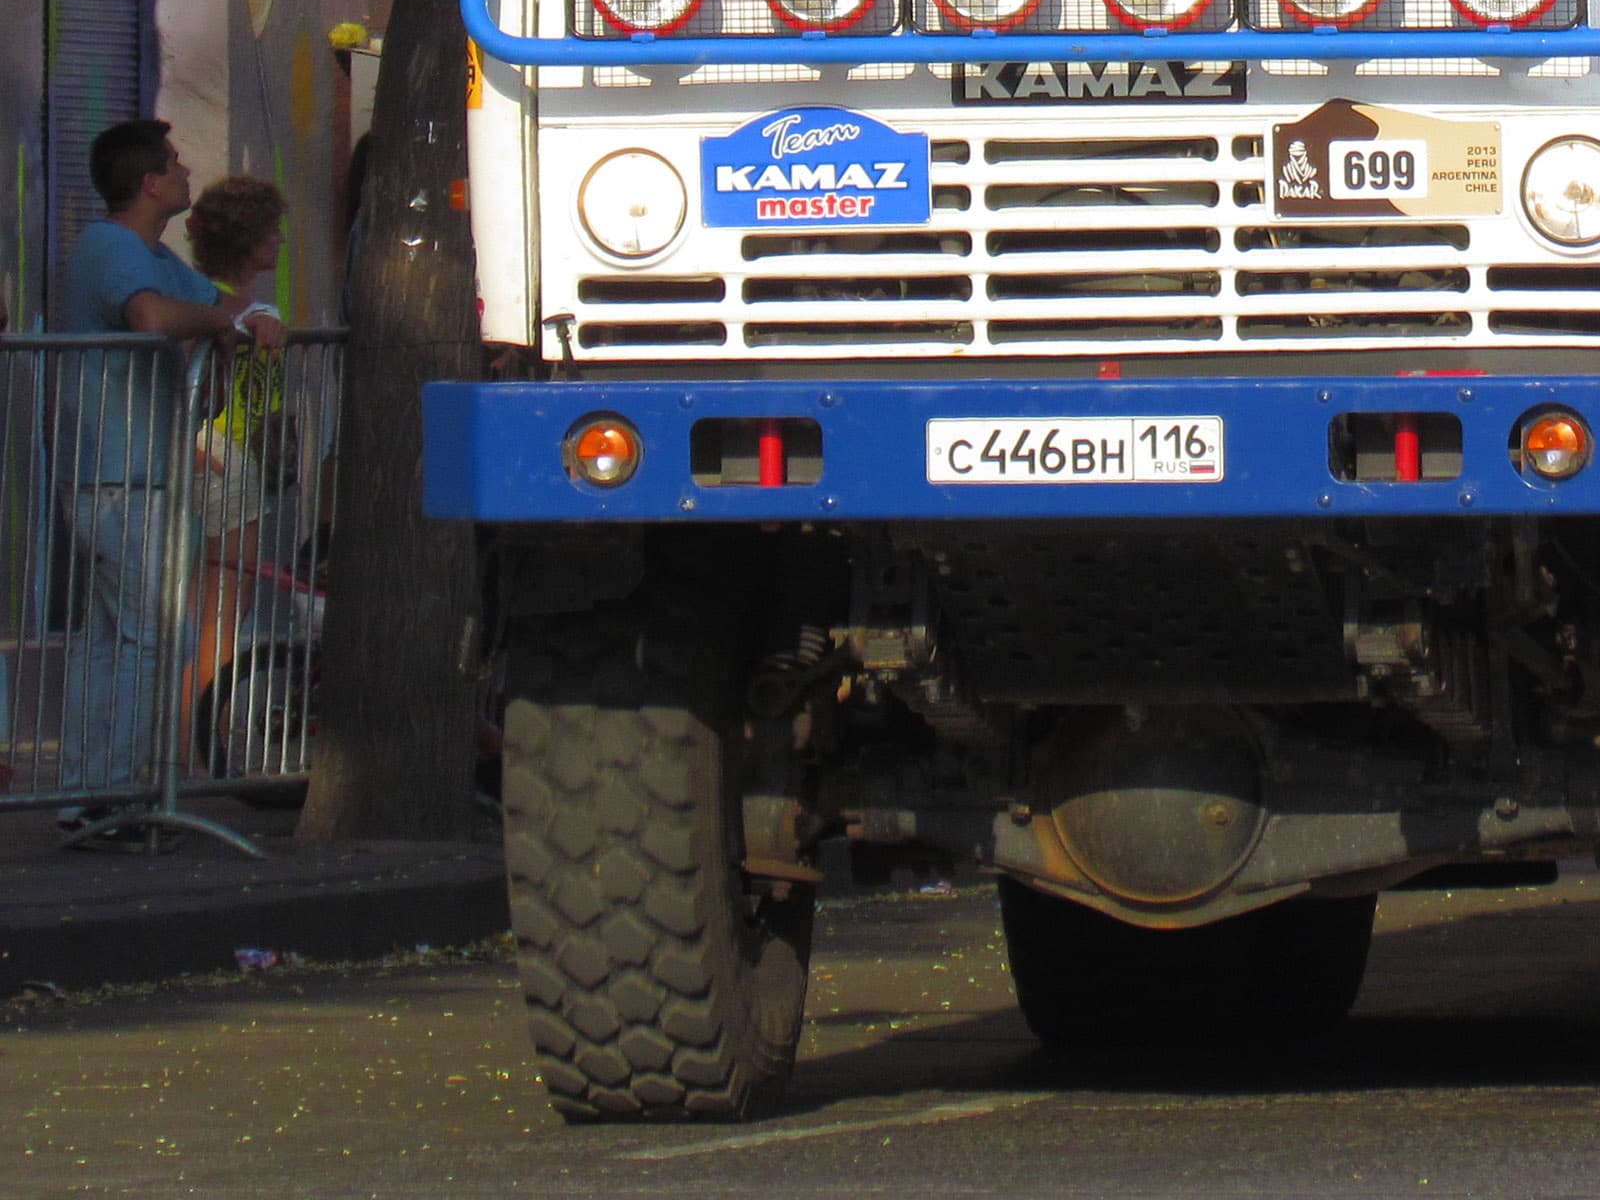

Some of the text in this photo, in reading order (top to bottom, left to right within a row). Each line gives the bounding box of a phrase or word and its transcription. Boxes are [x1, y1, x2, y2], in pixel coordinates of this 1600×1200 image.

[964, 60, 1236, 100] KAMAZ
[761, 113, 861, 159] Team
[1466, 146, 1497, 156] 2013
[1343, 150, 1416, 191] 699
[1466, 158, 1497, 168] PERU
[715, 162, 910, 193] KAMAZ
[1431, 171, 1498, 181] ARGENTINA
[1464, 182, 1498, 193] CHILE
[1278, 180, 1322, 200] DAKAR
[756, 193, 876, 220] master
[1138, 424, 1210, 460] 116
[1152, 460, 1190, 474] RUS
